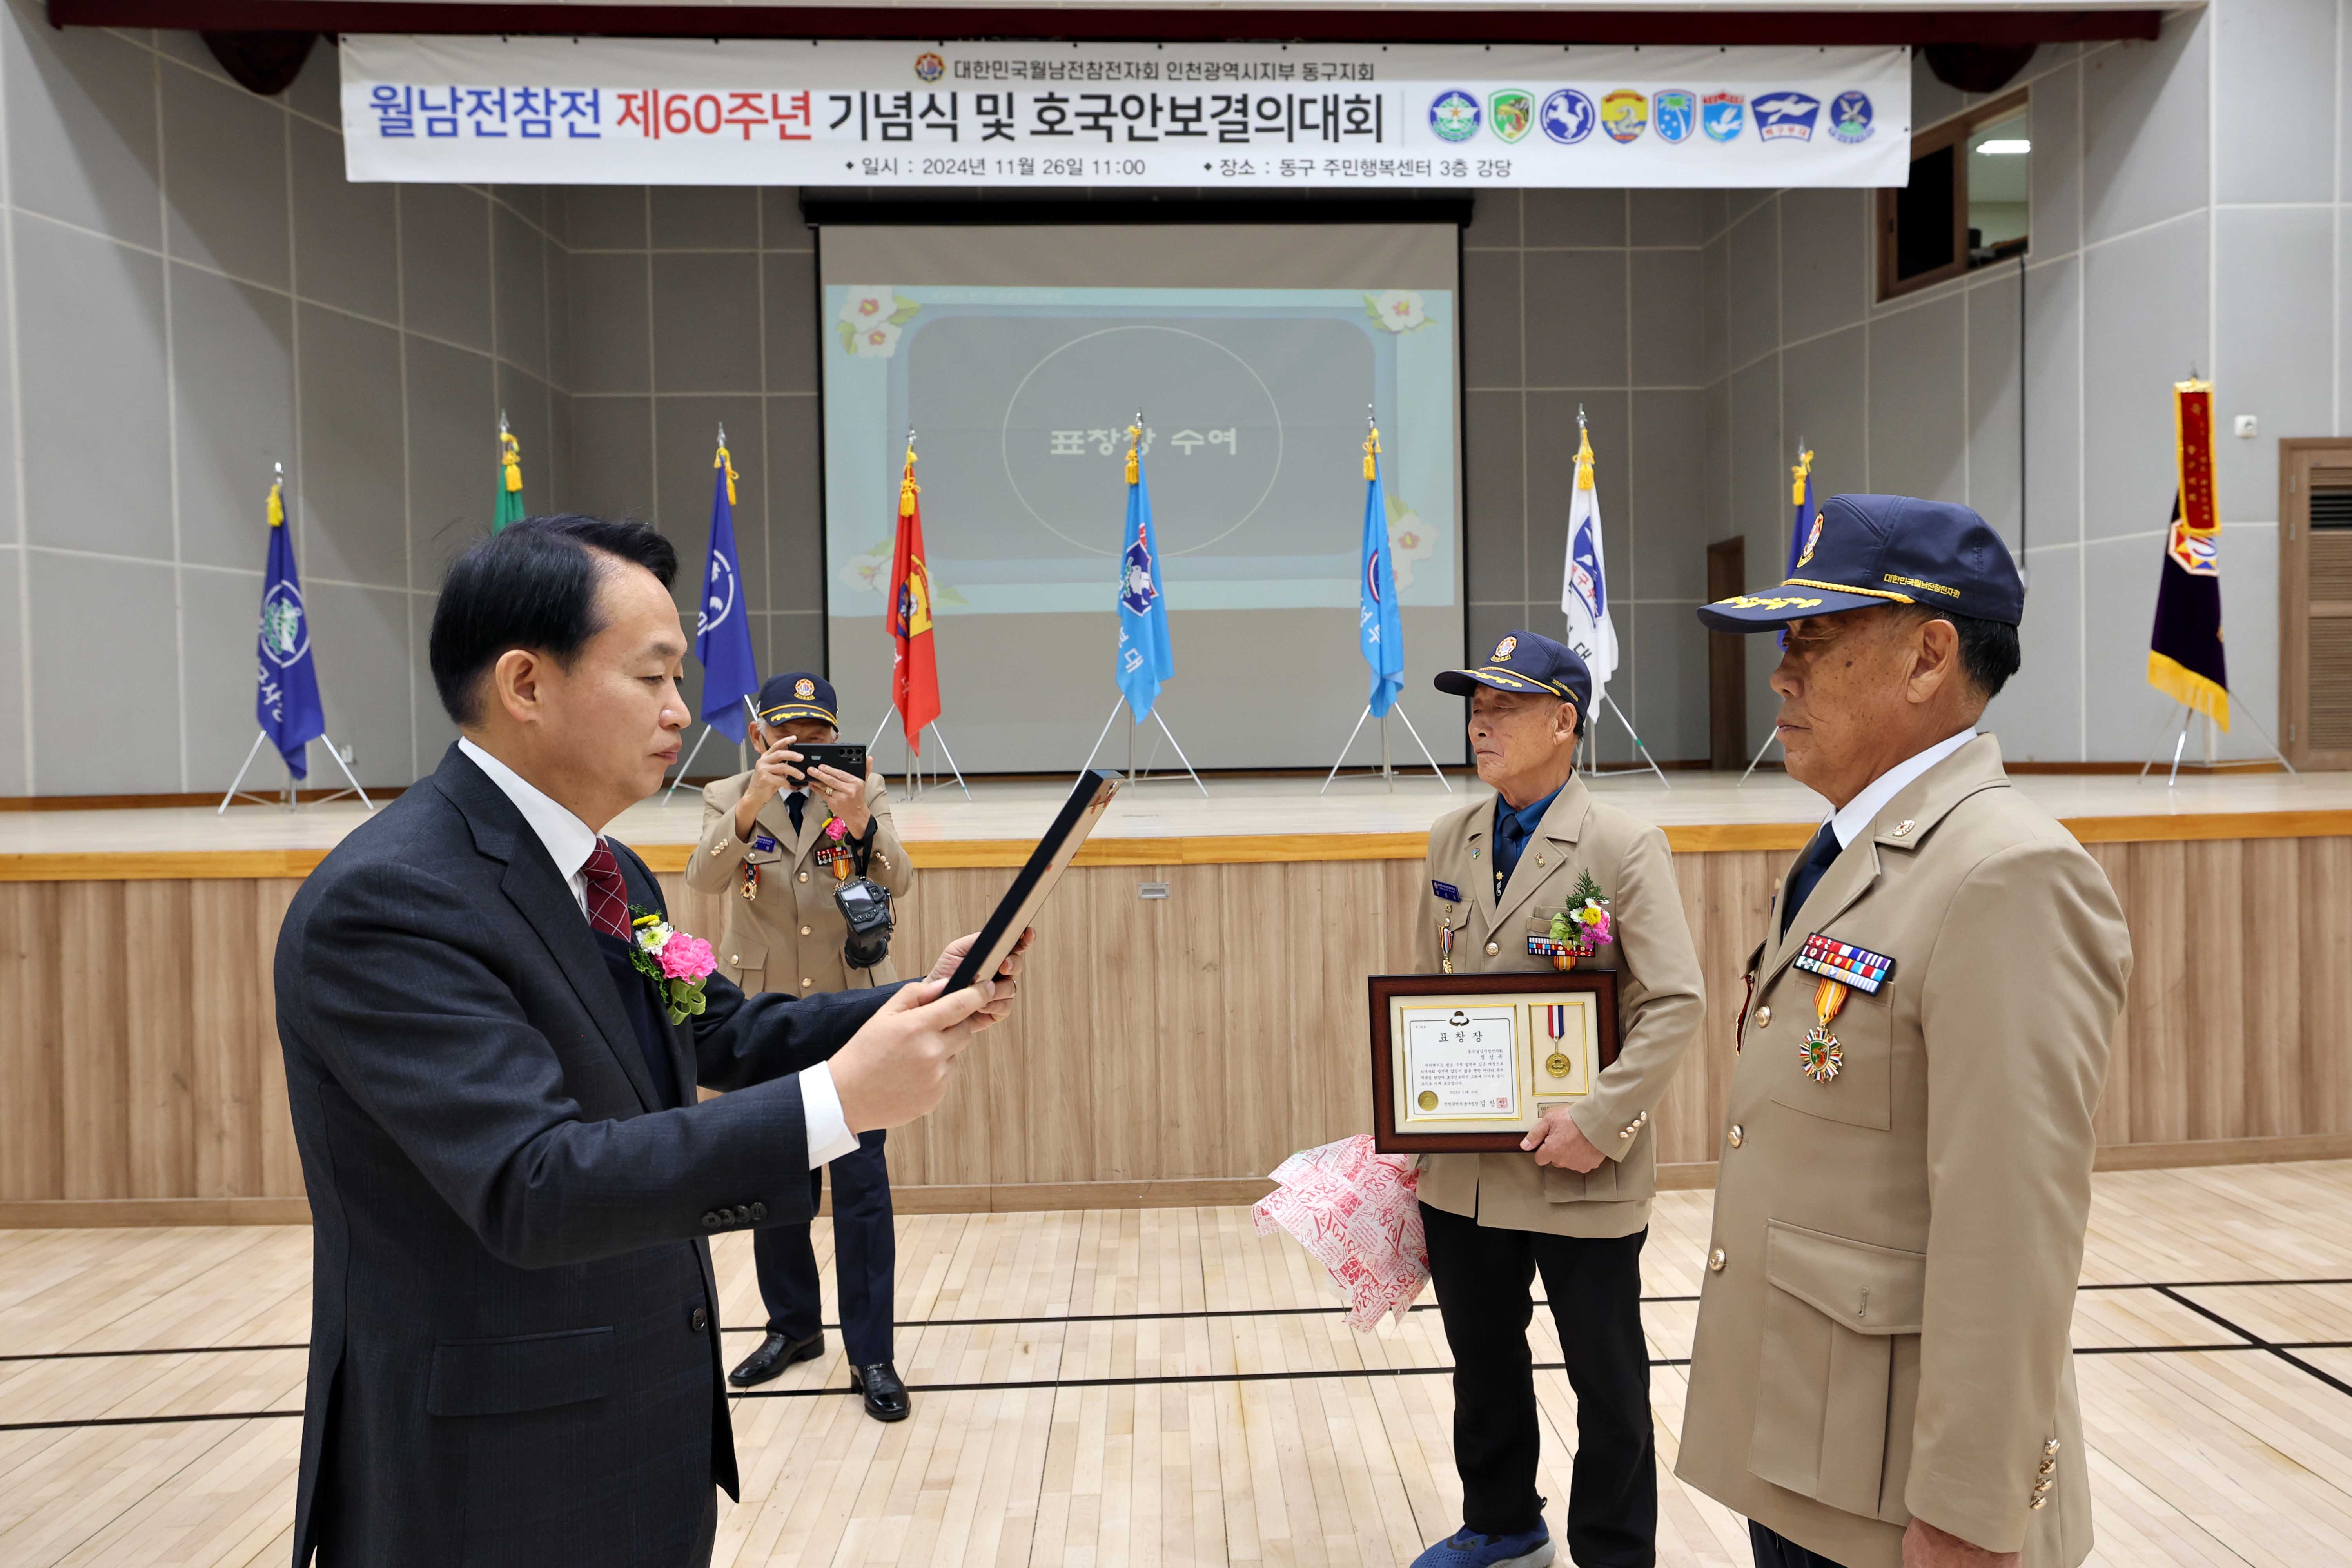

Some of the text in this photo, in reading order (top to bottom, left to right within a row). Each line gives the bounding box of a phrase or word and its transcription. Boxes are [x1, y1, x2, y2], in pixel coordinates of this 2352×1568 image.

[955, 60, 1374, 82] 대한민국월남전참전자회 인천광역시지부 동구지회
[370, 86, 1382, 143] 월남전참전 제60주년 기념식 및 호국안보결의대회
[862, 158, 897, 175] 일시
[923, 158, 985, 175] 2024년
[996, 157, 1034, 176] 11월
[1043, 158, 1082, 176] 26일
[1093, 160, 1145, 175] 11:00
[1221, 159, 1255, 176] 장소
[1281, 159, 1314, 177] 동구
[1324, 159, 1430, 177] 주민행복센터
[1441, 159, 1468, 177] 3층
[1478, 160, 1512, 177] 강당
[1171, 428, 1237, 455] 수여
